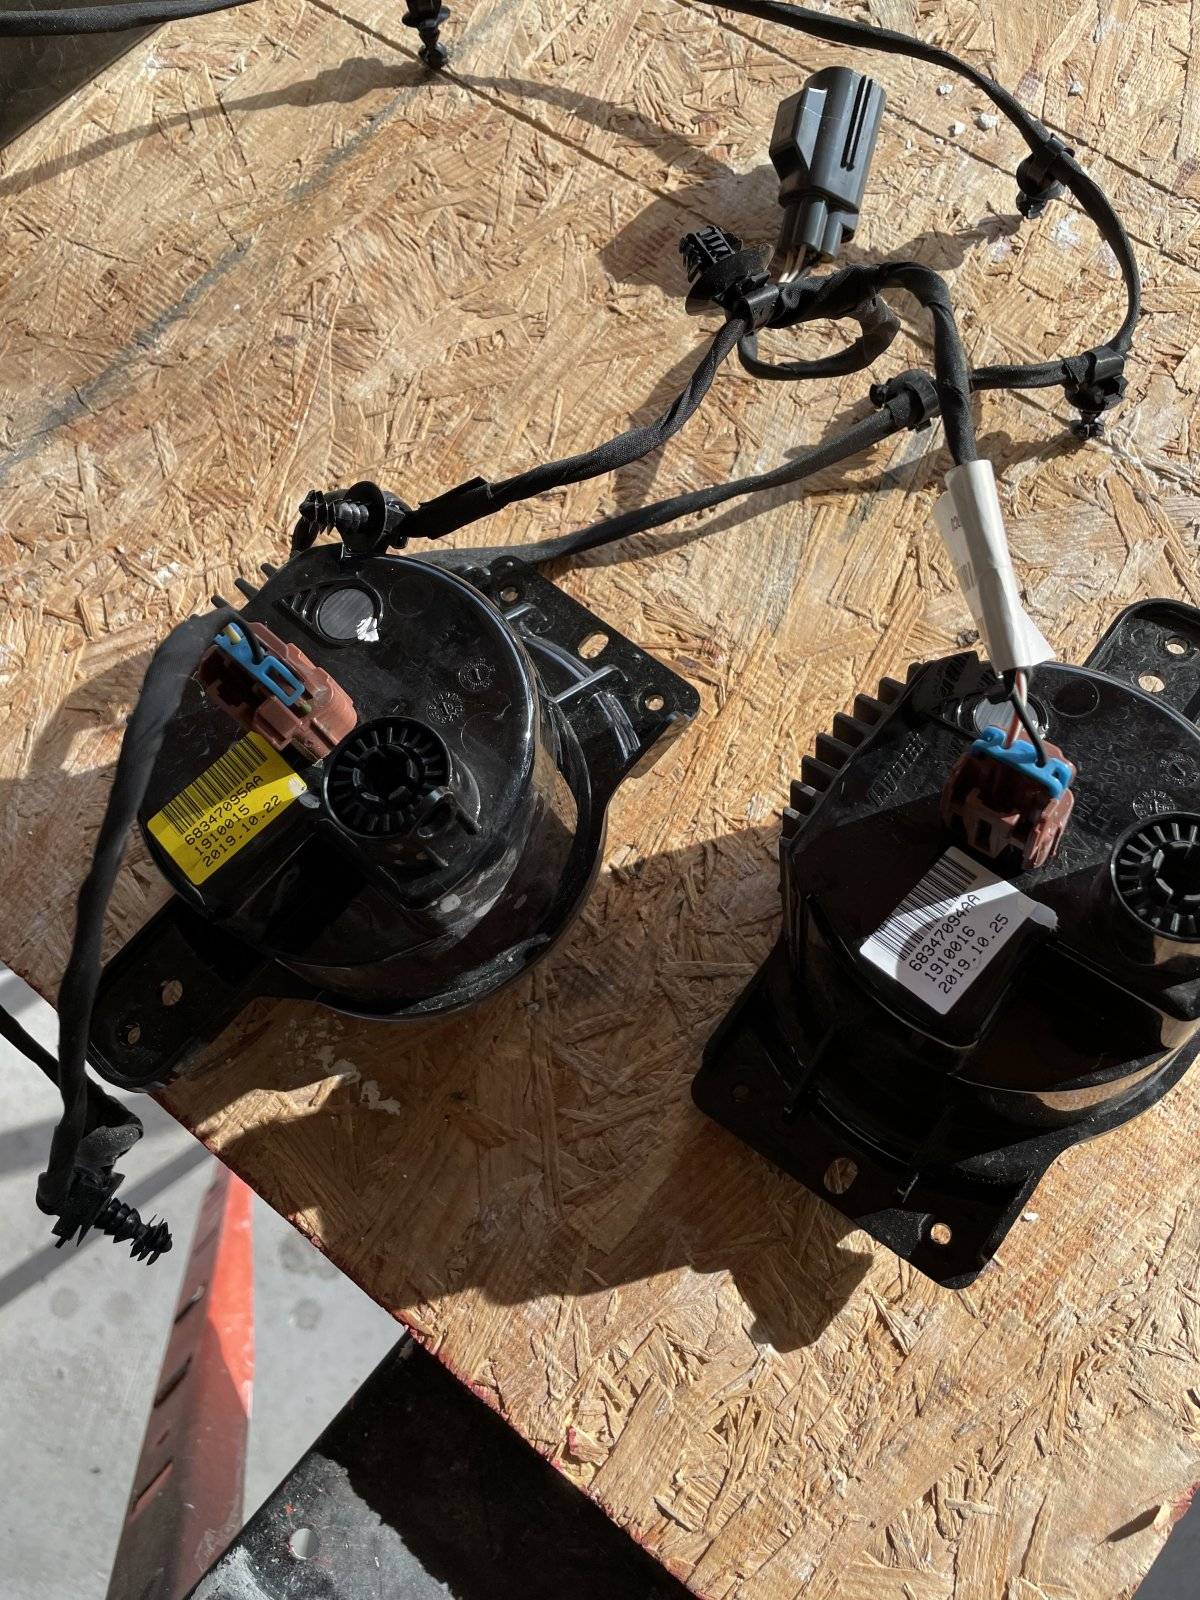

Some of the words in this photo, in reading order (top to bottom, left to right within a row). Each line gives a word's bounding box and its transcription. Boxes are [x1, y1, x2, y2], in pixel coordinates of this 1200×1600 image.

[184, 775, 264, 846] 68347095AA
[195, 804, 250, 856] 1910015
[202, 795, 281, 868] 2019.10.22
[908, 894, 981, 972] 68347094AA
[925, 926, 975, 982] 1910016
[938, 913, 1009, 994] 2019.10.25
